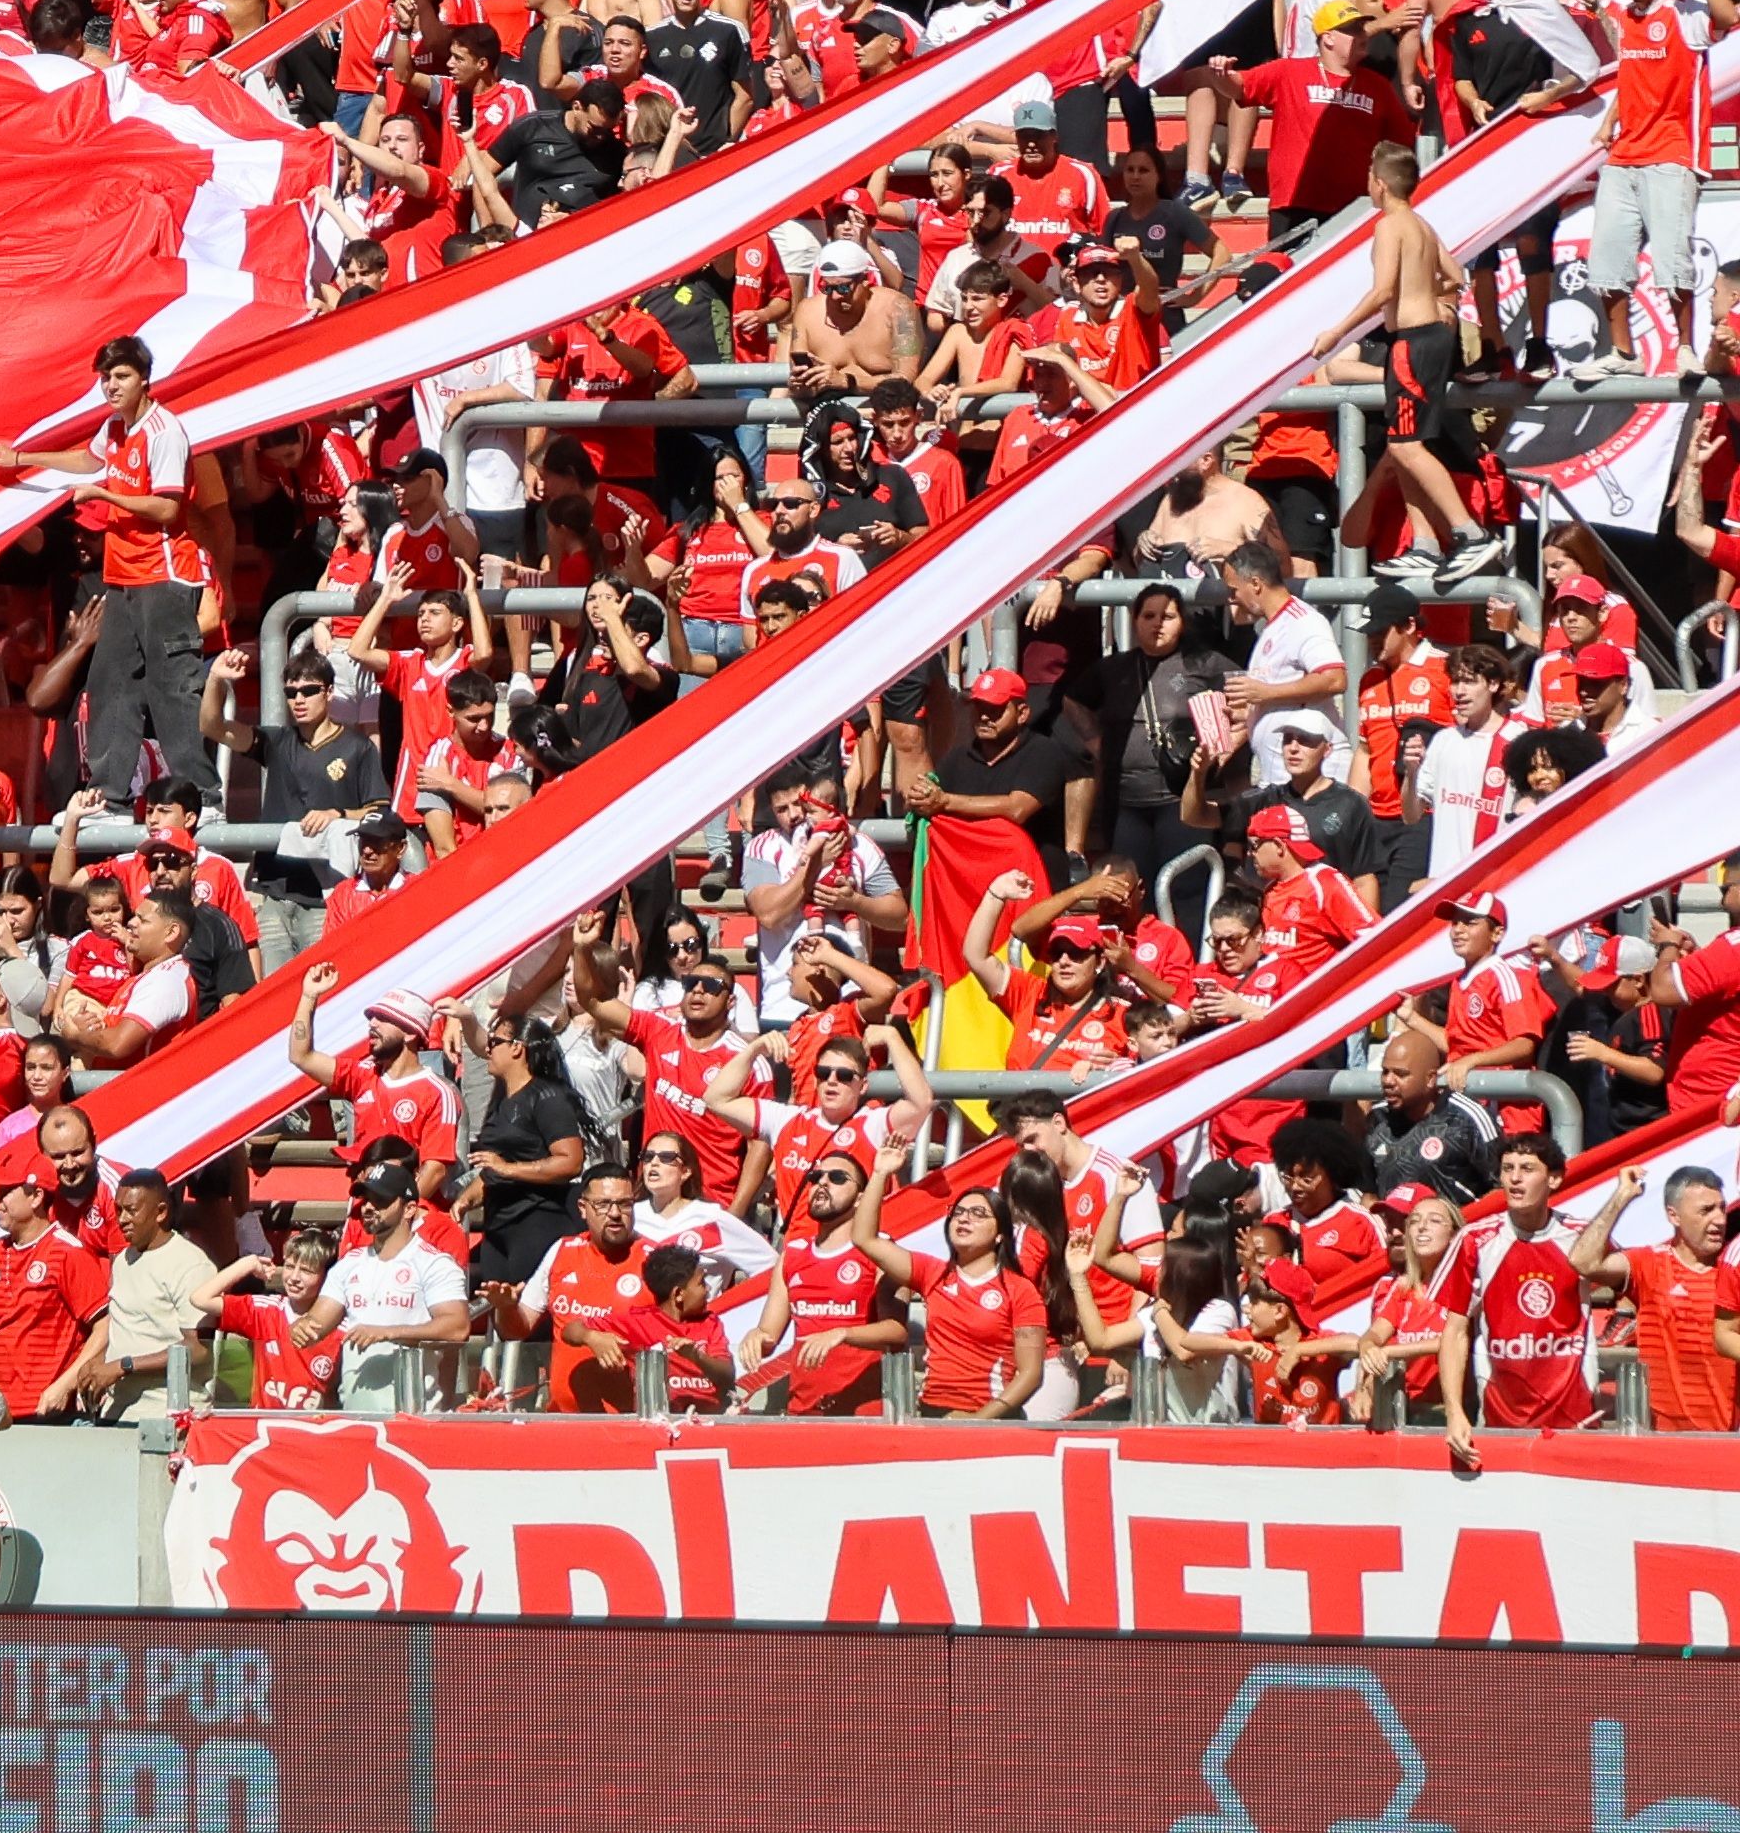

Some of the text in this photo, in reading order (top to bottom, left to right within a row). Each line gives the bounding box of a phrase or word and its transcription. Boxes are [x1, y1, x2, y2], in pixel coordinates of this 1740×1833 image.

[697, 551, 754, 566] banrisu
[571, 1297, 614, 1316] banri
[797, 1298, 857, 1315] Banrisul
[1488, 1334, 1586, 1359] adidas
[264, 1380, 322, 1408] alfa
[145, 1647, 274, 1725] POR
